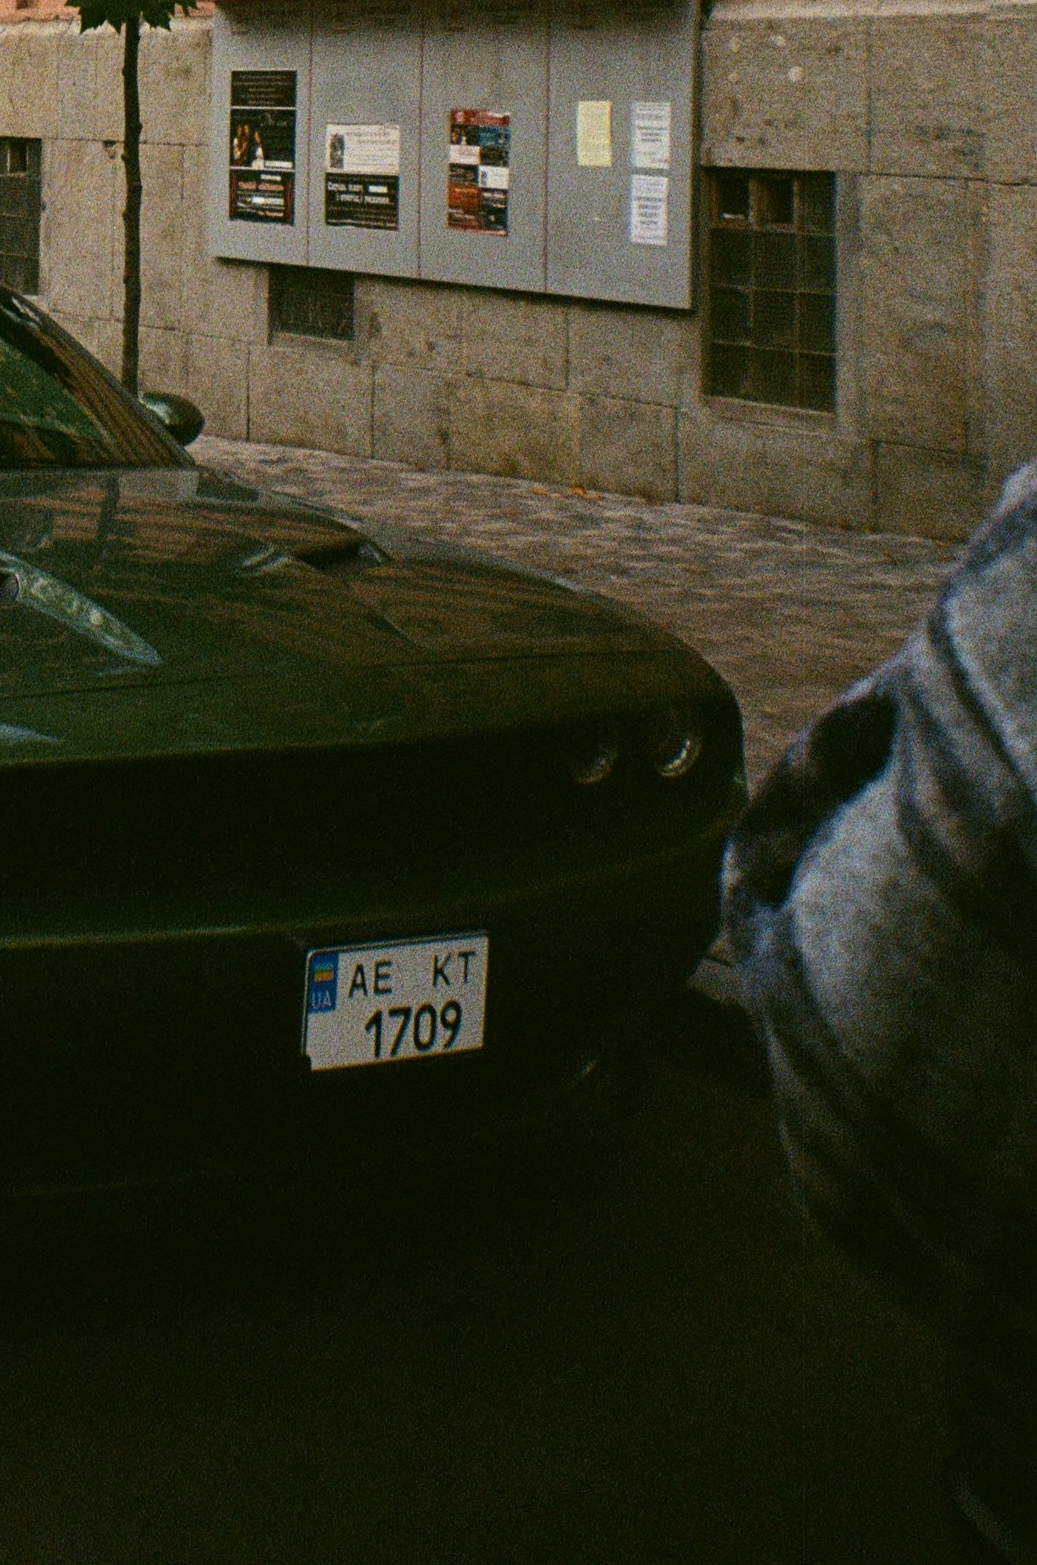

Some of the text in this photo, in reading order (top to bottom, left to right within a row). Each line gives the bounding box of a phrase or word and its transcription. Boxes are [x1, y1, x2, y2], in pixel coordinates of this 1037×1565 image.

[348, 949, 476, 998] AE KT
[310, 990, 333, 1010] UA
[364, 999, 463, 1060] 1709
